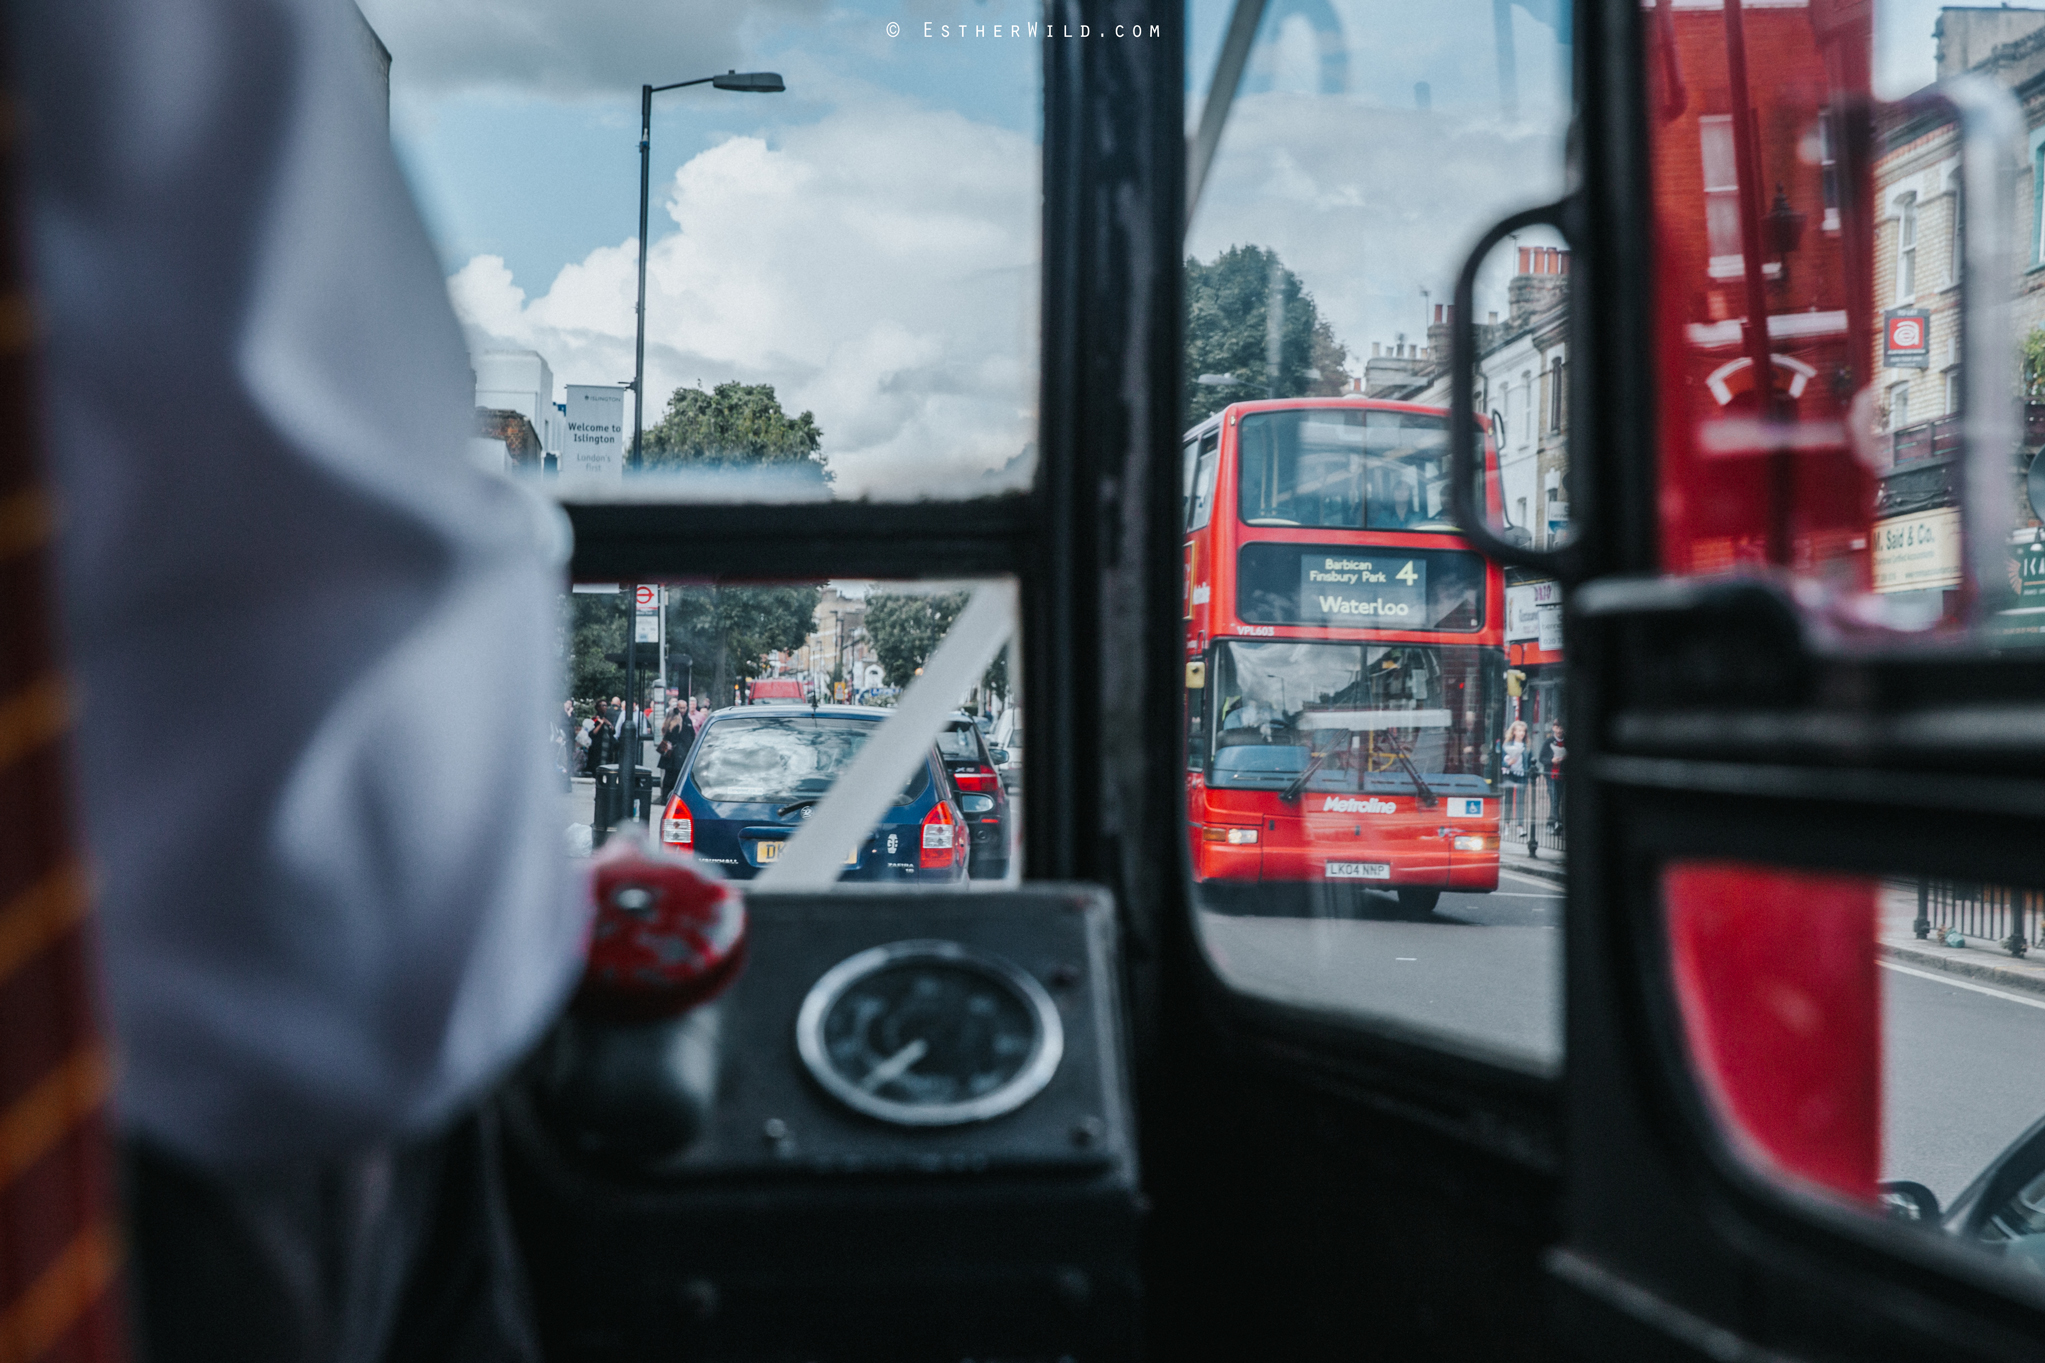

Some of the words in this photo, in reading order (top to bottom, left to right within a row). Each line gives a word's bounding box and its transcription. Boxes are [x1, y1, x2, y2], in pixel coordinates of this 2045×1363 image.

[568, 422, 609, 432] Welcome
[612, 424, 621, 432] to
[573, 433, 615, 445] Islington
[577, 453, 611, 462] London's
[1886, 526, 1905, 551] Said
[1907, 525, 1914, 547] &
[1325, 558, 1373, 571] Barbican
[1309, 570, 1359, 585] Finsbury
[1362, 571, 1387, 583] Park
[1395, 560, 1418, 586] 4
[1319, 595, 1409, 616] Waterloo
[1237, 625, 1275, 636] VPL603
[1323, 796, 1396, 814] Metroline
[1330, 864, 1359, 876] LK04
